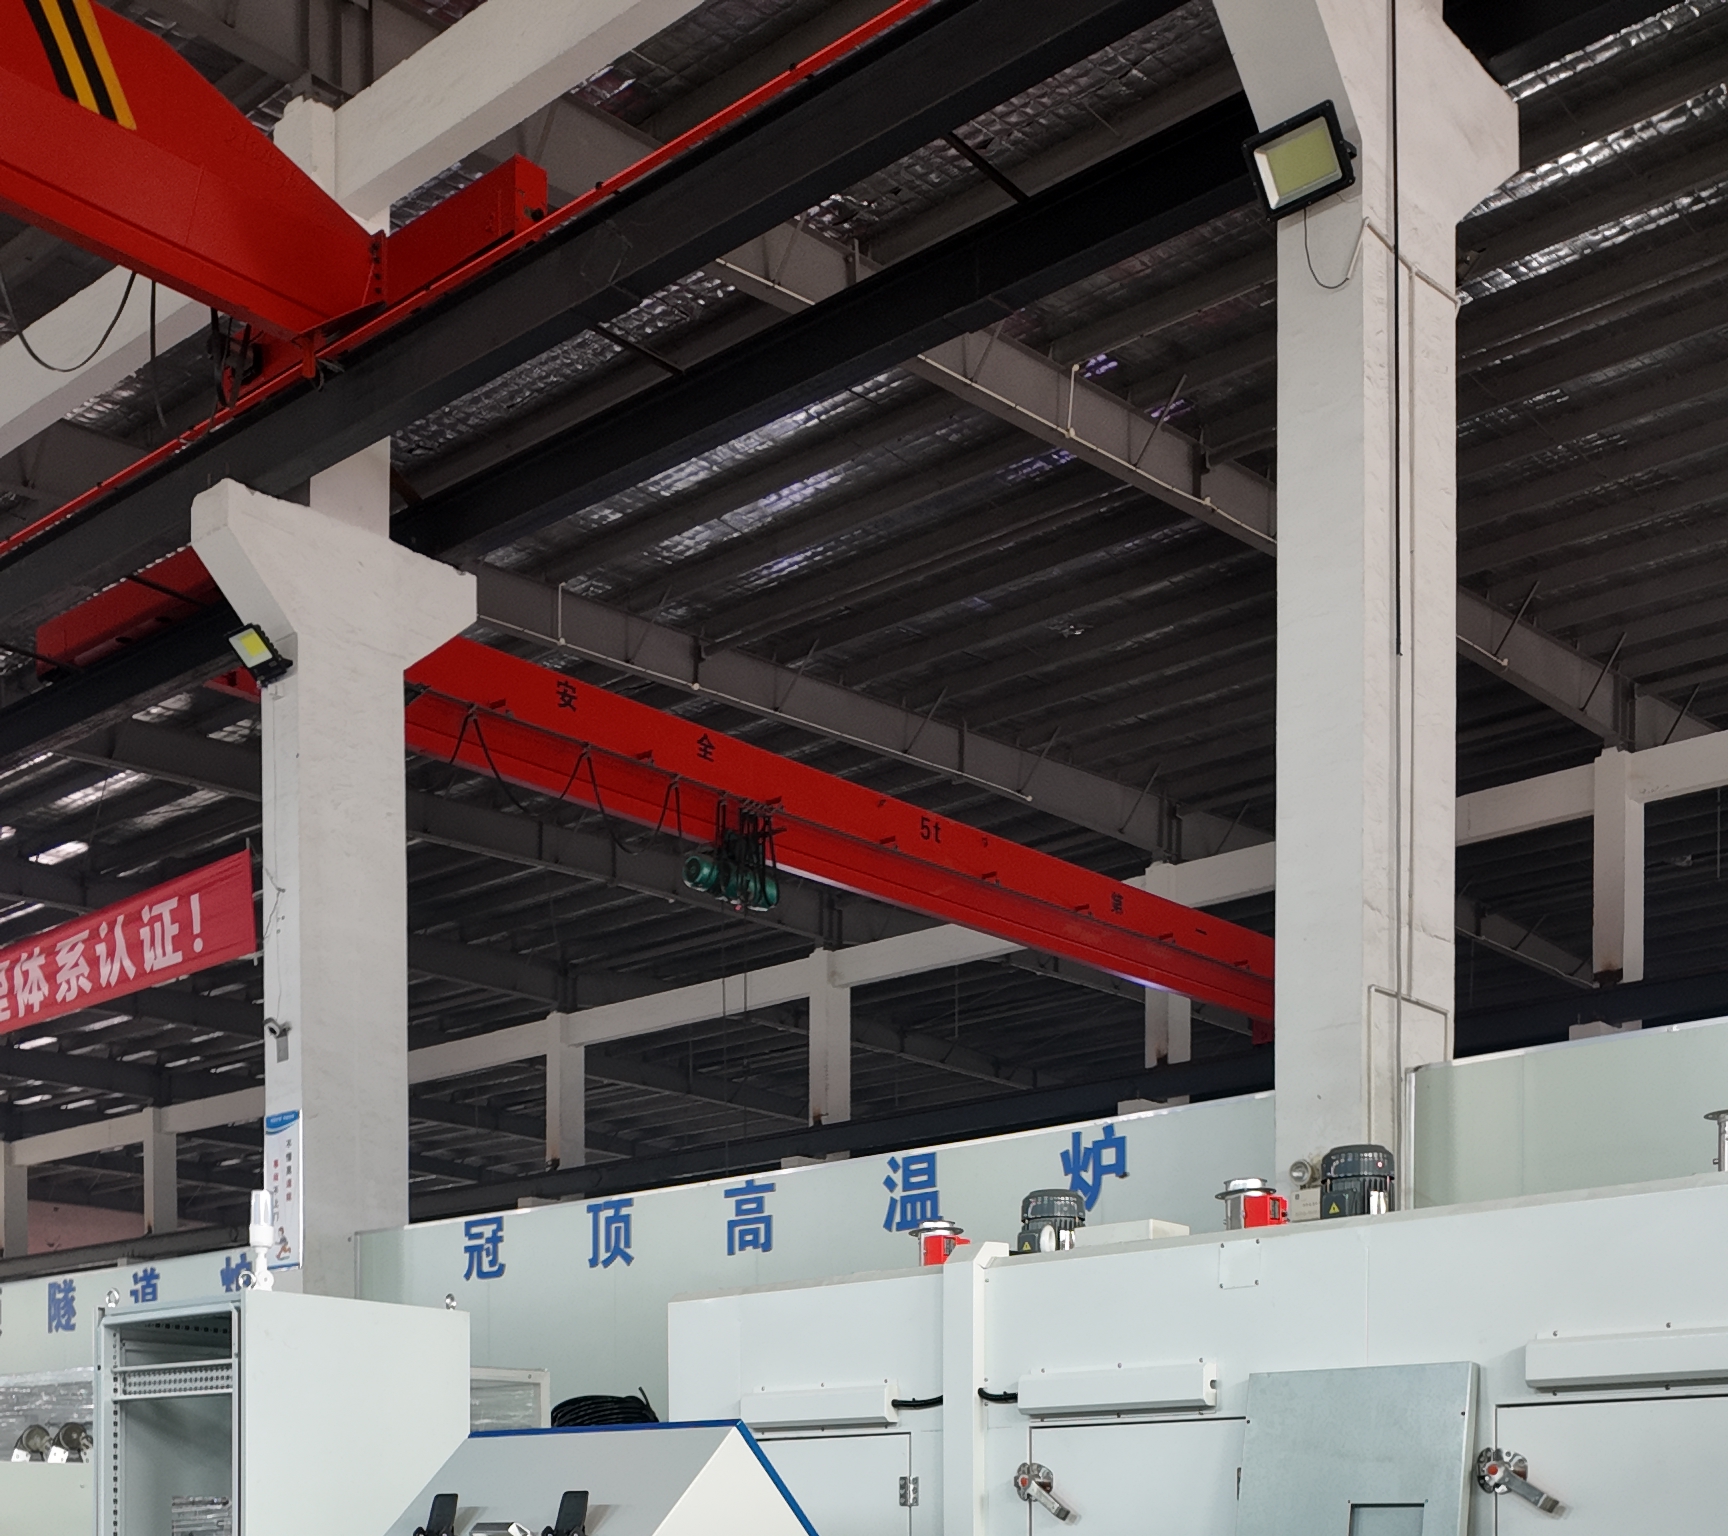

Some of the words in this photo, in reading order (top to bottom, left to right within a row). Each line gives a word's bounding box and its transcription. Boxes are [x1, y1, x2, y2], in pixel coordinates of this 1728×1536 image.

[920, 815, 942, 844] 5t
[463, 1124, 1131, 1281] 冠顶高温炉
[0, 1252, 253, 1334] 隧道炉
